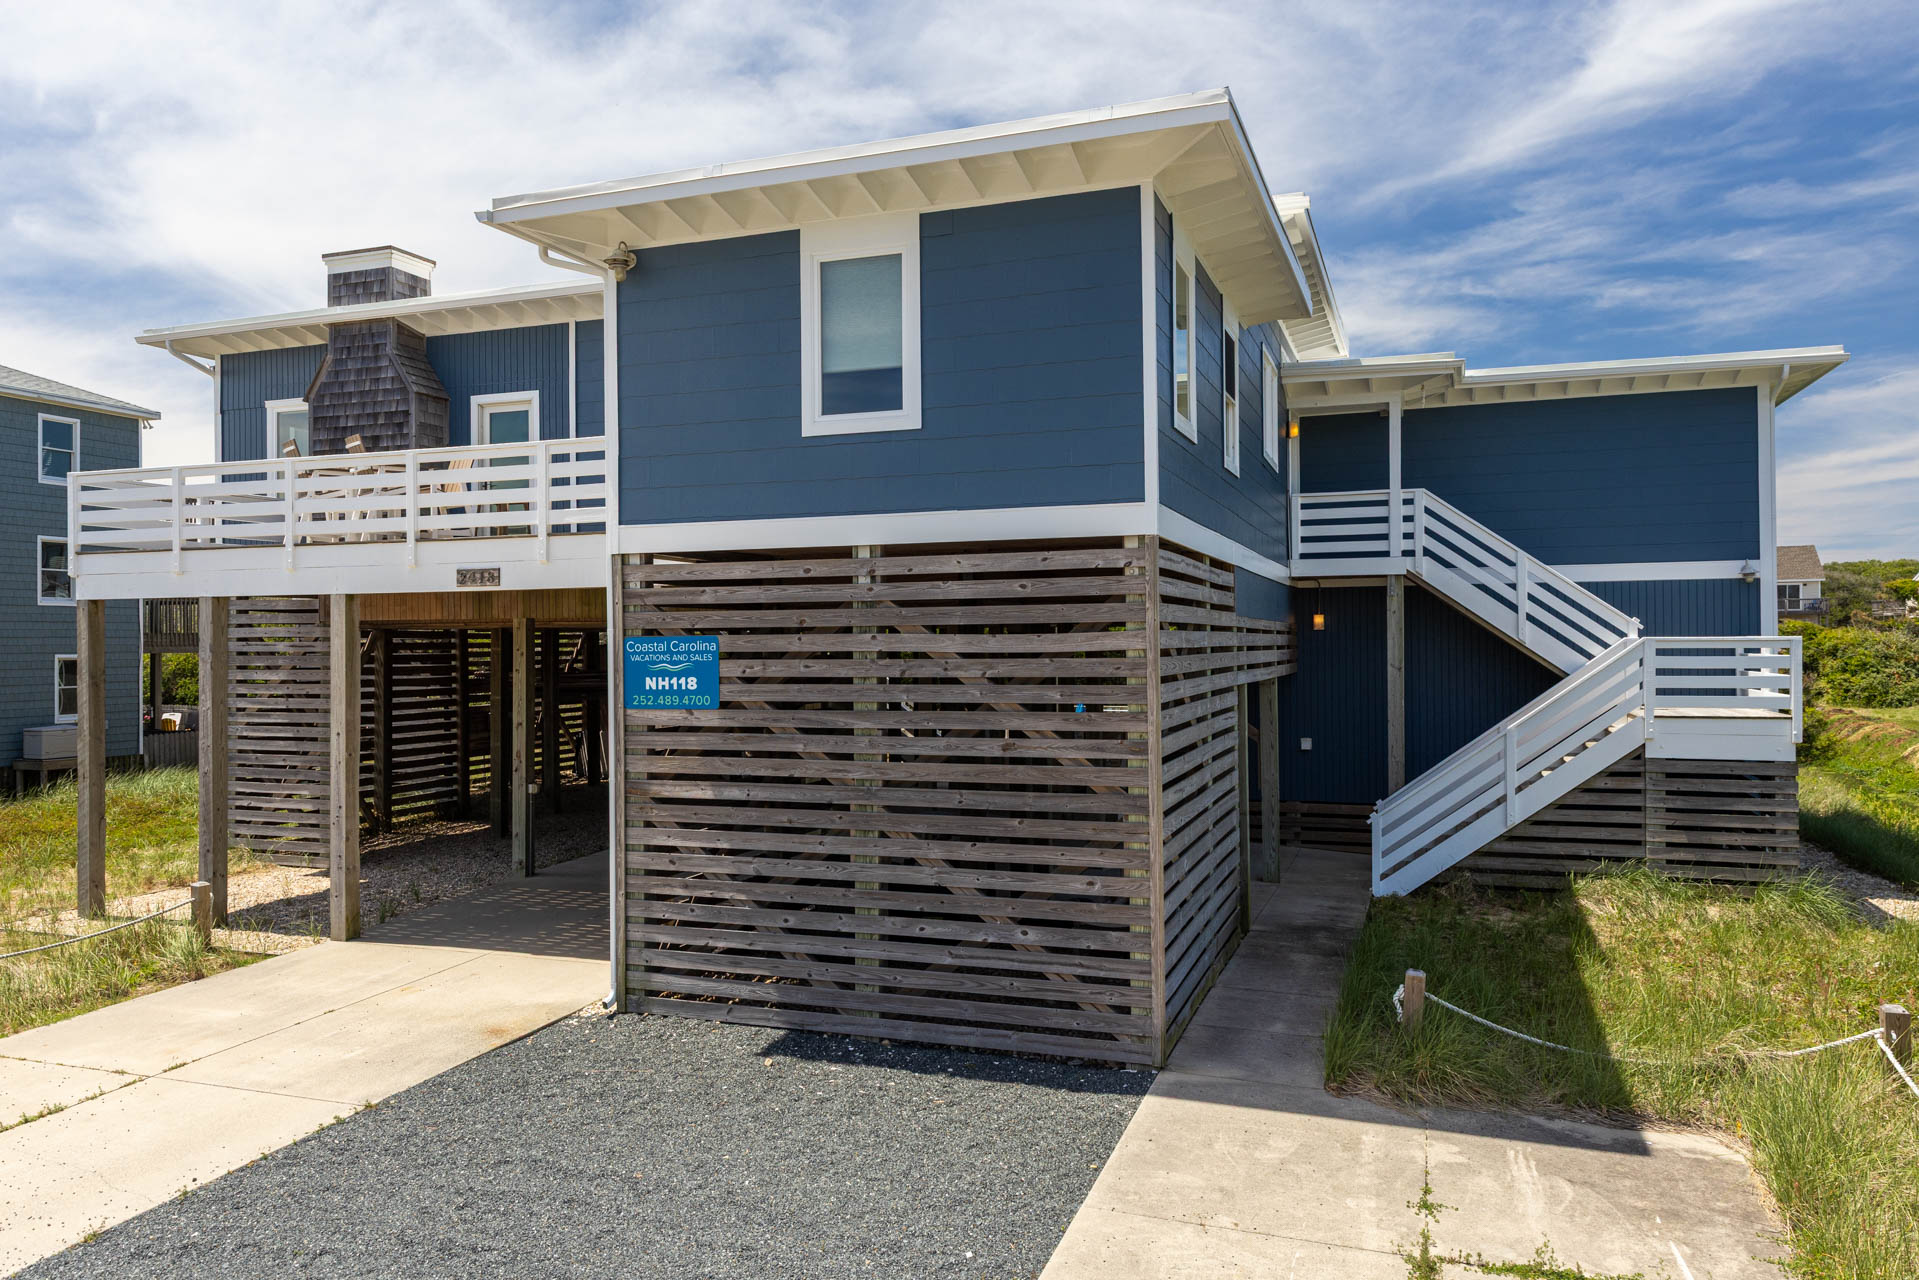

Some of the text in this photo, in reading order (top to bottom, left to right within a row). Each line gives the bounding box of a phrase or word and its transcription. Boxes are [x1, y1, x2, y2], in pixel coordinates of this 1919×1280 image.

[626, 640, 717, 653] Coastal Carolina
[630, 653, 713, 662] VACATIONS AND SALES
[645, 676, 698, 690] NH118
[632, 695, 711, 706] 252.489.4700
